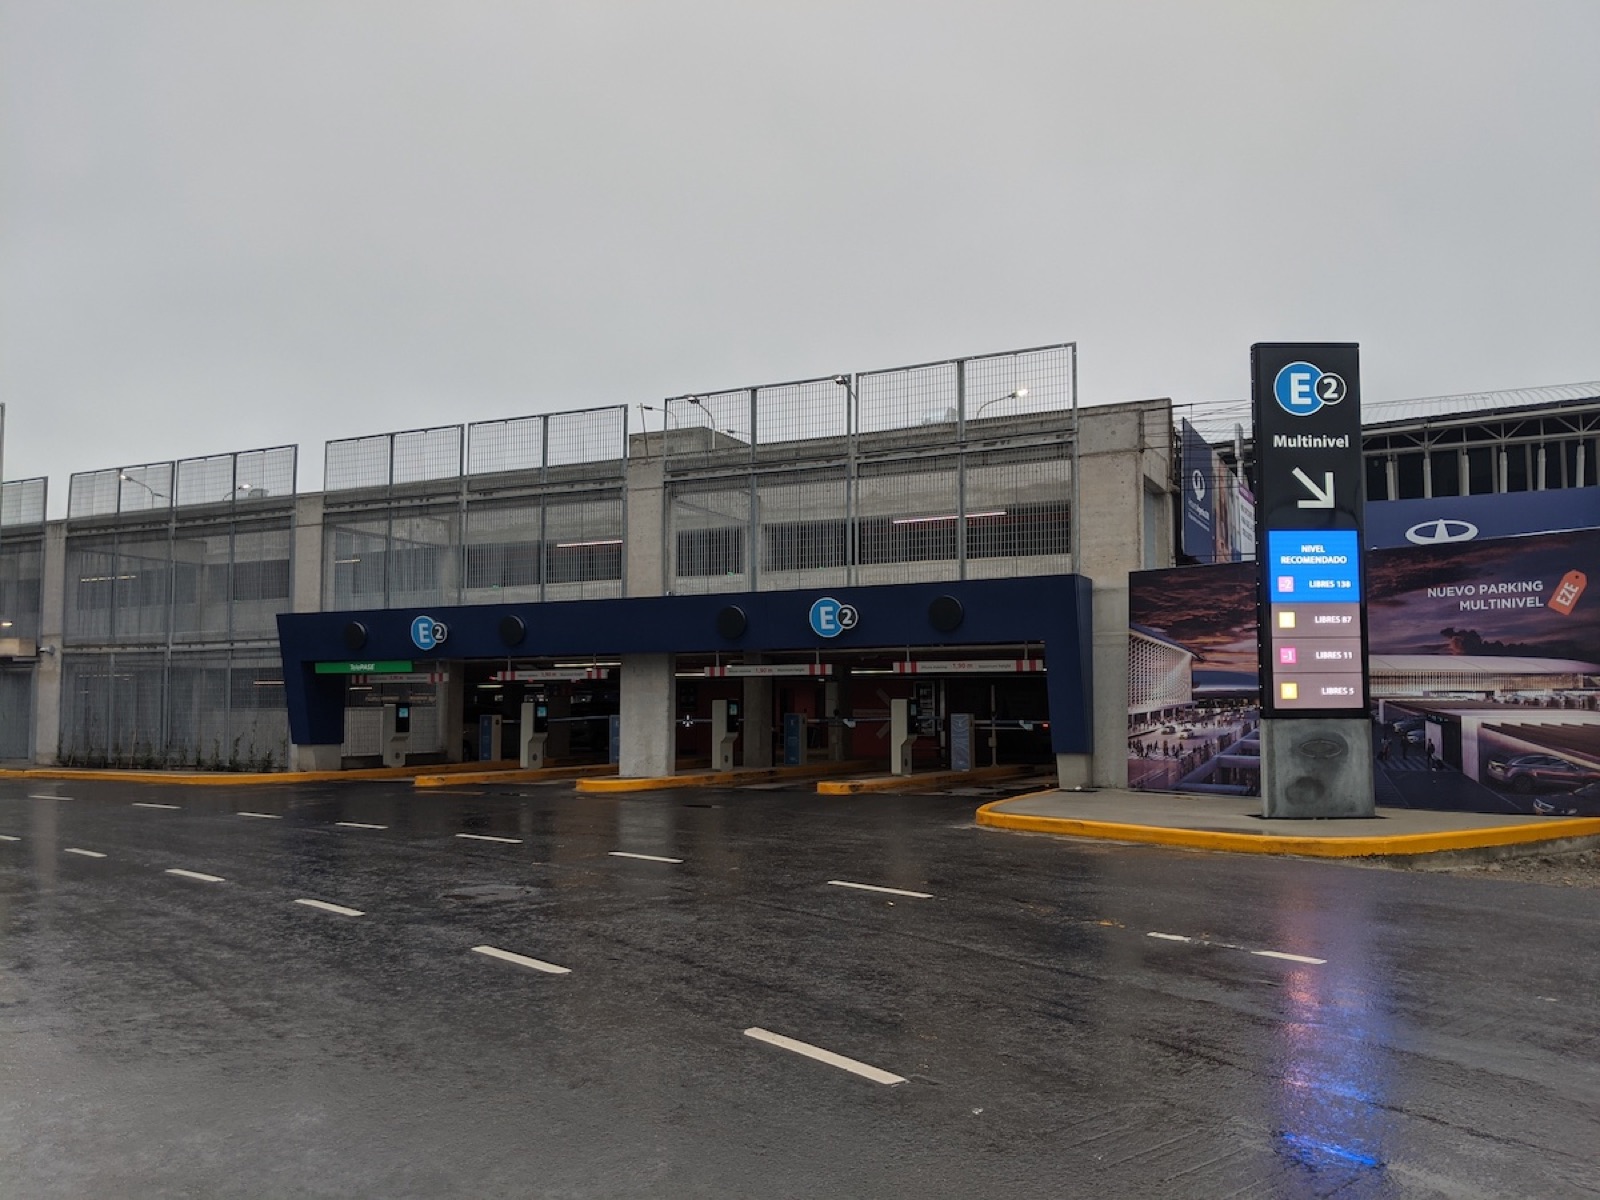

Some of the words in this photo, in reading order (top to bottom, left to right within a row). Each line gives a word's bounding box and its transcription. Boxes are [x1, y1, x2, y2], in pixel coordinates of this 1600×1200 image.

[1290, 372, 1312, 405] E
[1322, 378, 1338, 399] 2
[1273, 434, 1349, 448] Multinivel
[1301, 544, 1326, 553] NIVEL
[1280, 555, 1347, 565] RECOMENDADO
[1309, 580, 1335, 589] LIBRES
[1427, 585, 1475, 598] NUEVO
[1479, 580, 1543, 596] PARKING
[1556, 581, 1580, 607] EZE
[1459, 596, 1544, 611] MULTINIVEL
[820, 606, 835, 630] E
[842, 608, 853, 625] 2
[1314, 615, 1341, 624] LIBRES
[418, 623, 430, 644] E
[434, 626, 444, 640] 2
[1316, 651, 1342, 660] LIBRES
[1343, 651, 1353, 660] 11
[1321, 687, 1348, 696] LIBRES
